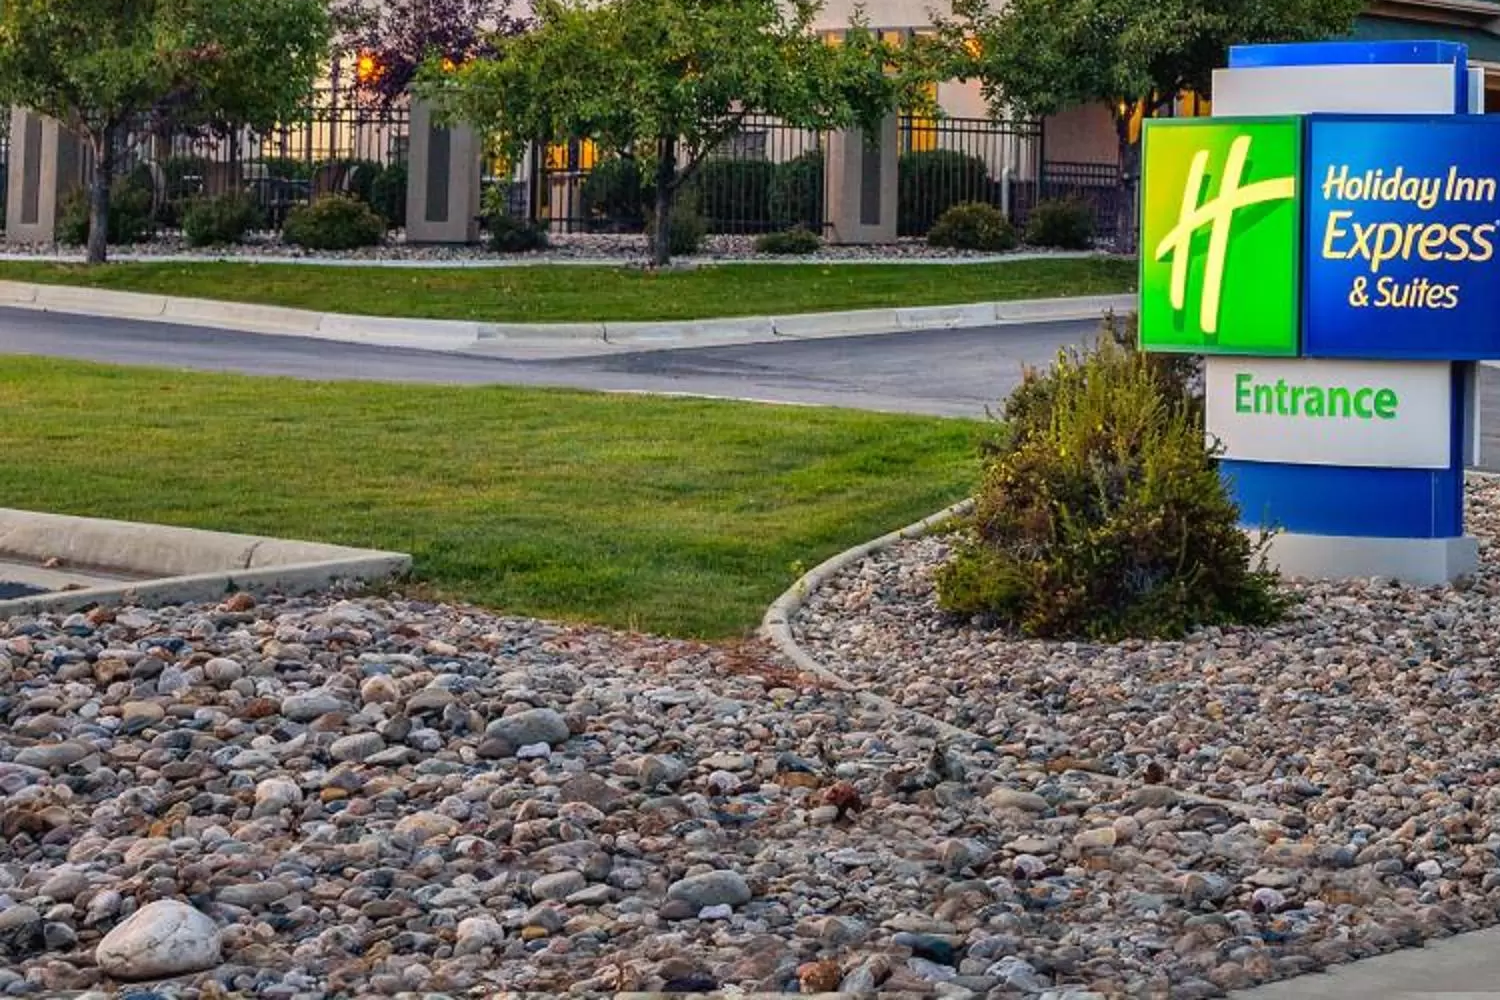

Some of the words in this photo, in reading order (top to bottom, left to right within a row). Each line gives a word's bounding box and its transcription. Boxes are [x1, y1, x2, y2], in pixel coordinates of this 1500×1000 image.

[1322, 165, 1439, 210] Holiday
[1444, 166, 1497, 202] Inn
[1322, 210, 1496, 272] Express
[1349, 278, 1369, 308] &
[1373, 277, 1460, 310] Suites
[1235, 373, 1399, 419] Entrance
